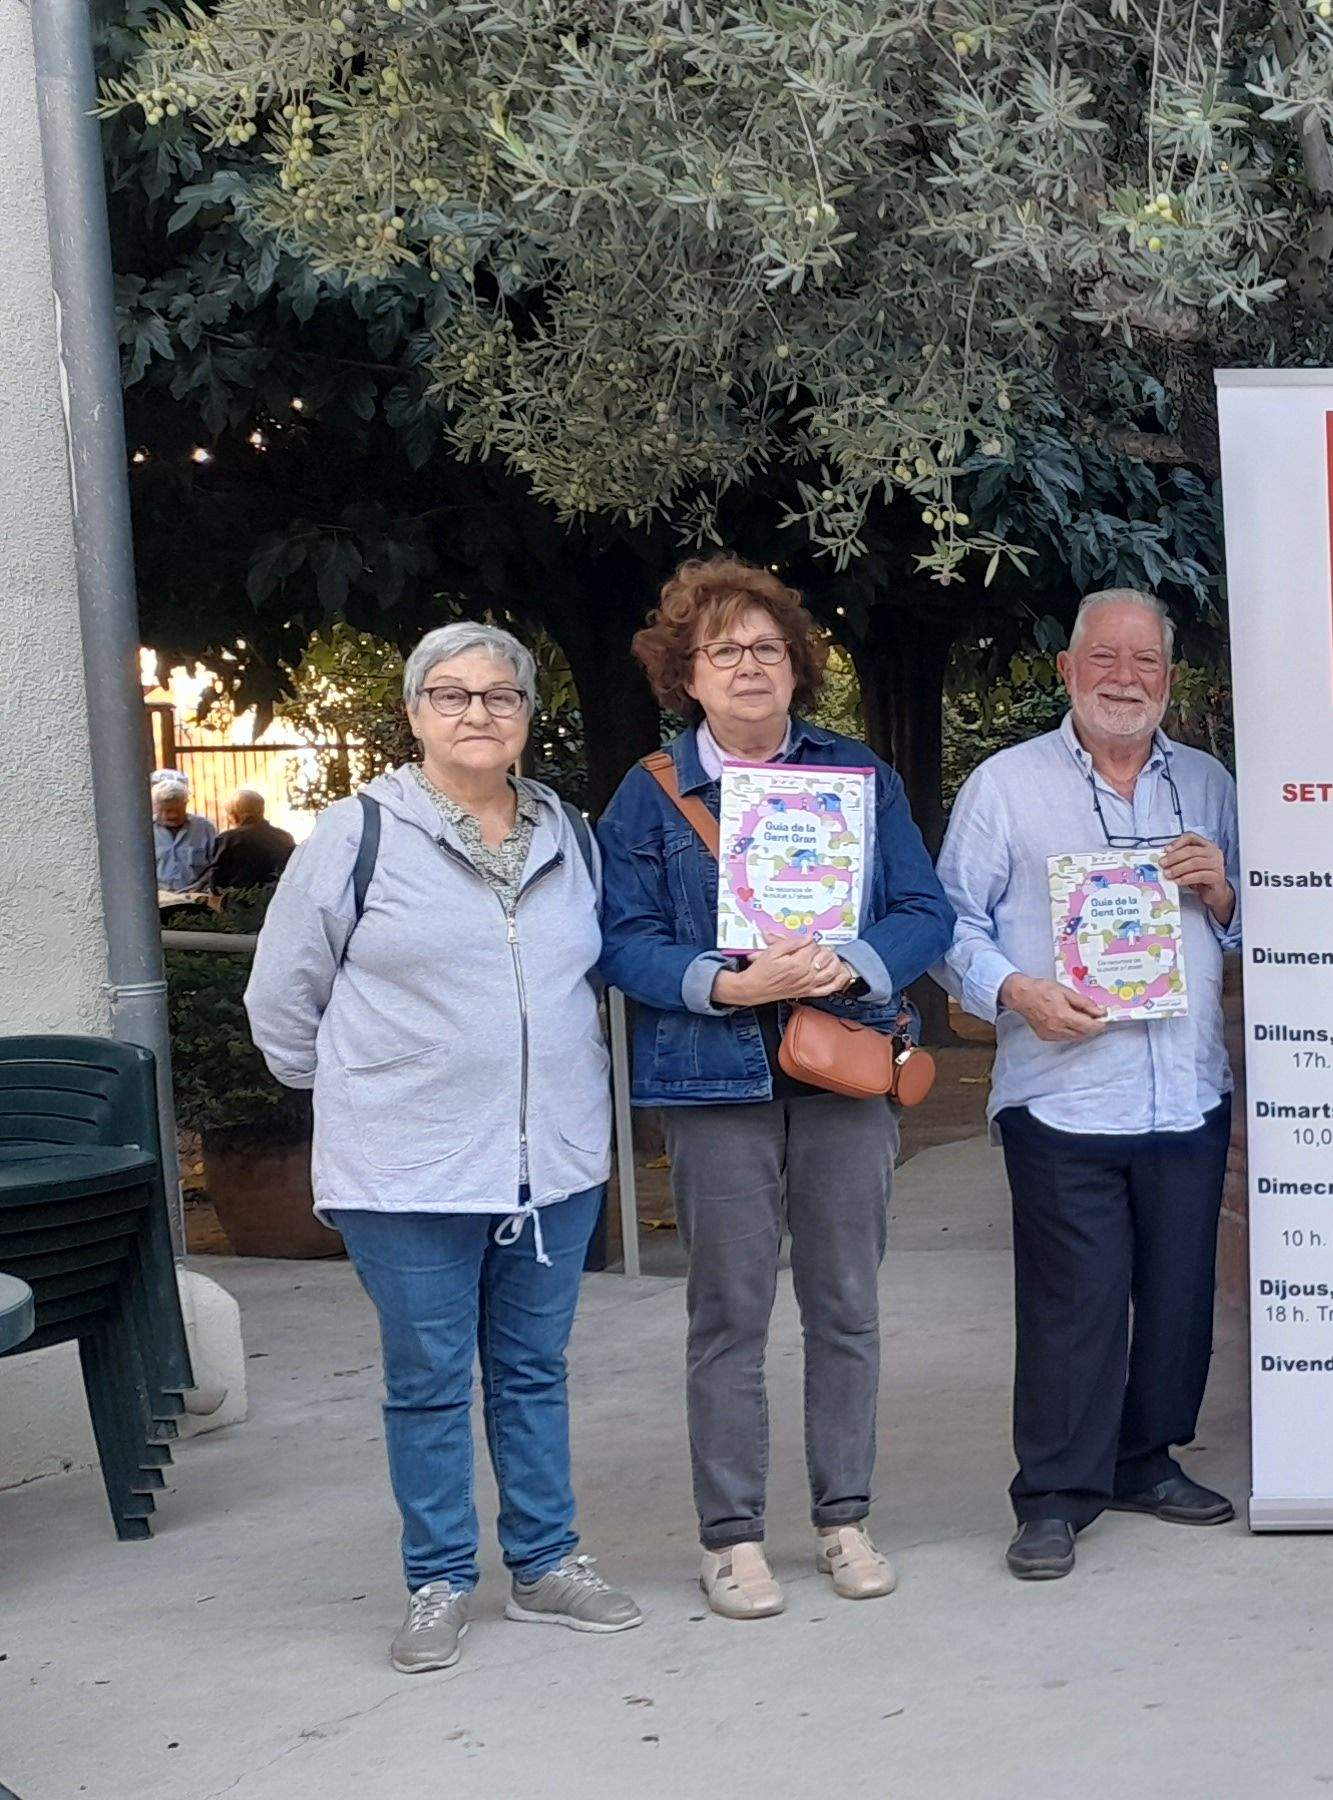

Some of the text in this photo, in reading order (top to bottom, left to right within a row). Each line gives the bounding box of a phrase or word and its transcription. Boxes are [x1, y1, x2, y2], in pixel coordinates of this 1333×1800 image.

[765, 821, 816, 833] Guia de la
[763, 832, 817, 844] Gent Gran
[1292, 1051, 1331, 1069] 17h.
[1282, 1229, 1304, 1247] 10
[1309, 1229, 1327, 1247] h.
[1265, 1305, 1287, 1323] 18
[1292, 1305, 1310, 1323] h.
